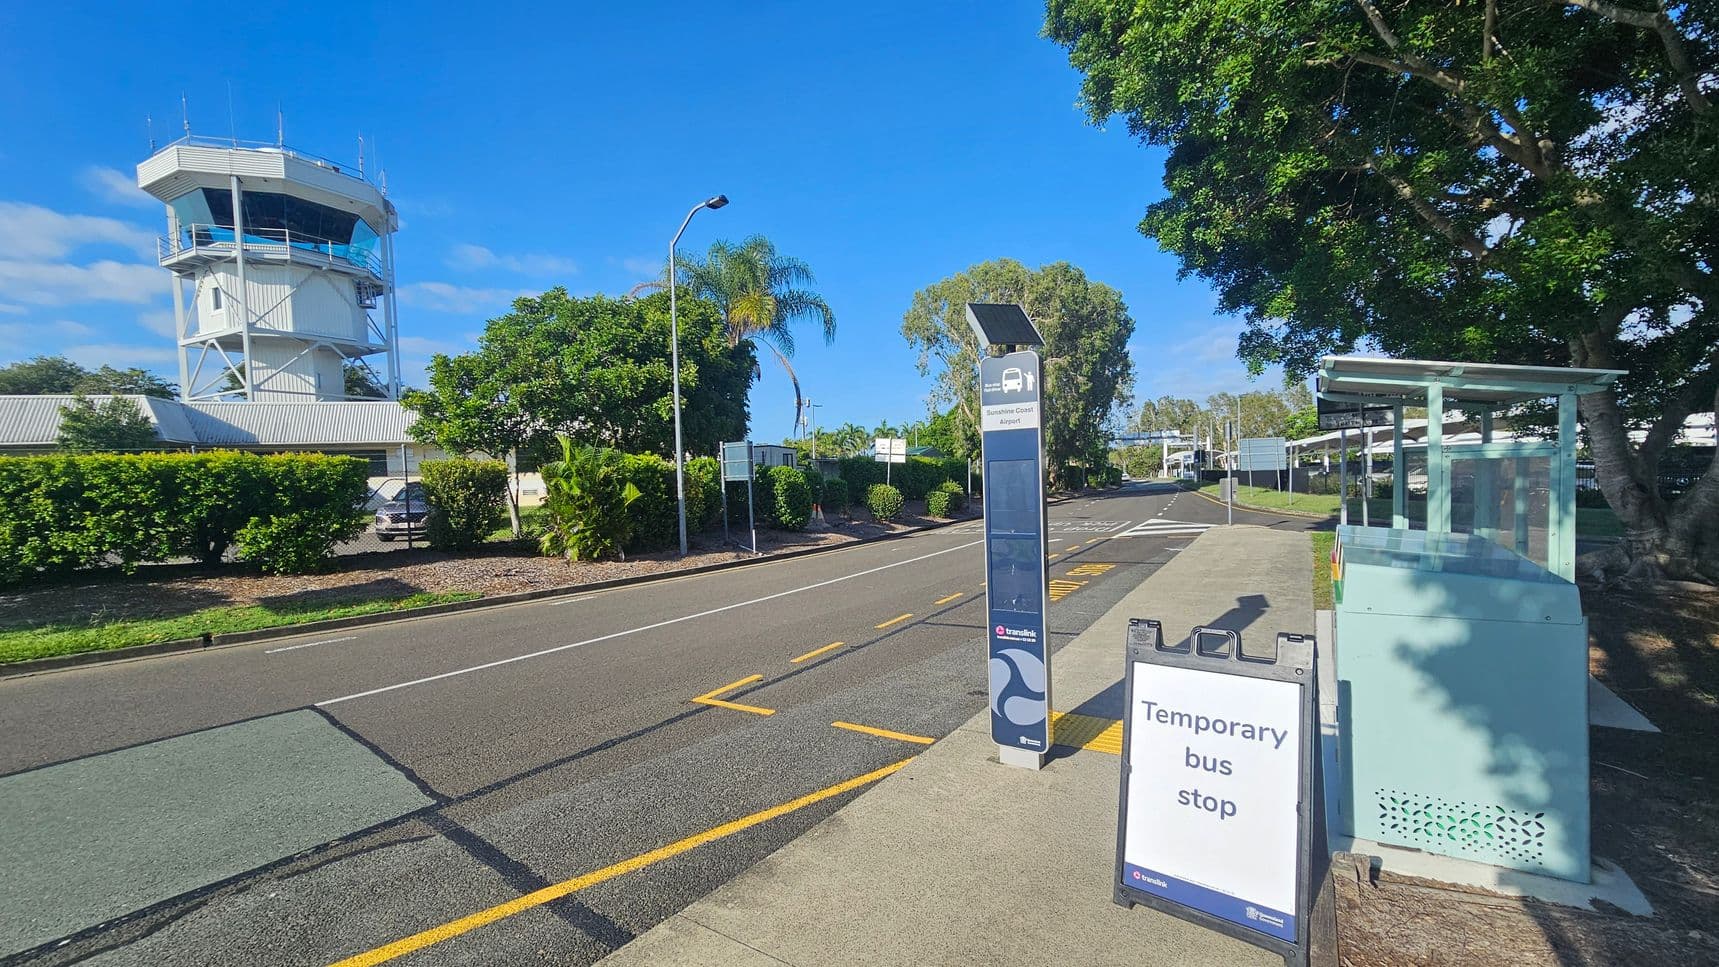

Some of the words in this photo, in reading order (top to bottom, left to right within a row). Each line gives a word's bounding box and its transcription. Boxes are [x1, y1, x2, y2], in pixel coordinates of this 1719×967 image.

[1006, 628, 1037, 638] translink
[1141, 700, 1288, 749] Temporary
[1185, 746, 1233, 776] bus
[1177, 789, 1237, 820] stop
[1141, 874, 1168, 888] translink
